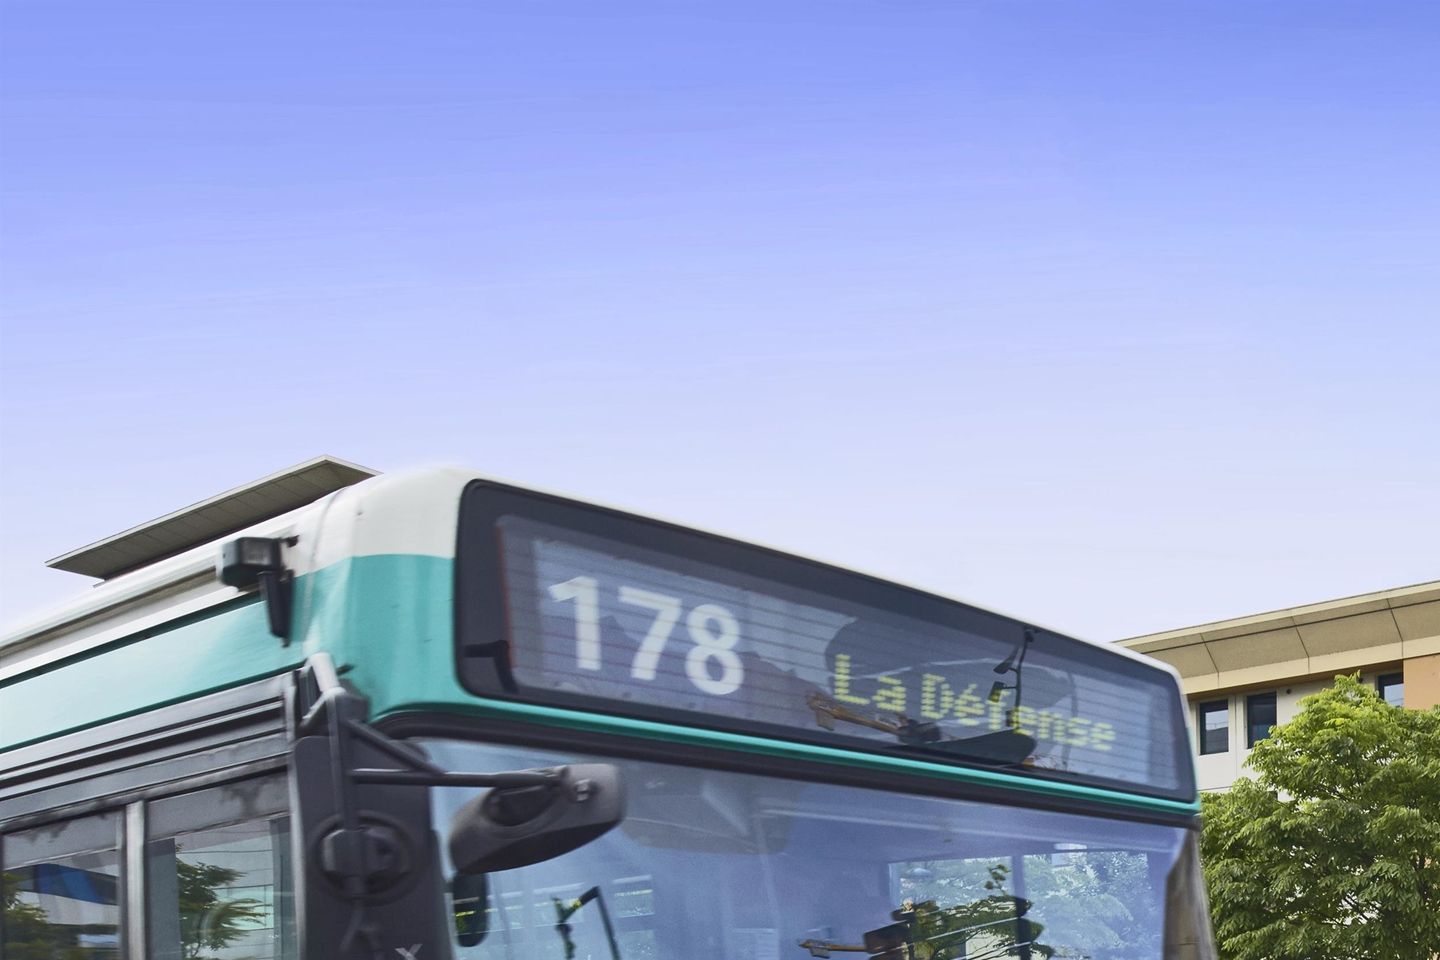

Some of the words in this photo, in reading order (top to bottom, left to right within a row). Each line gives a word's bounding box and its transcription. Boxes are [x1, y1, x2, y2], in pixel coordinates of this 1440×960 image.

[549, 576, 745, 695] 178
[834, 654, 906, 711] La
[921, 673, 1116, 750] Défense
